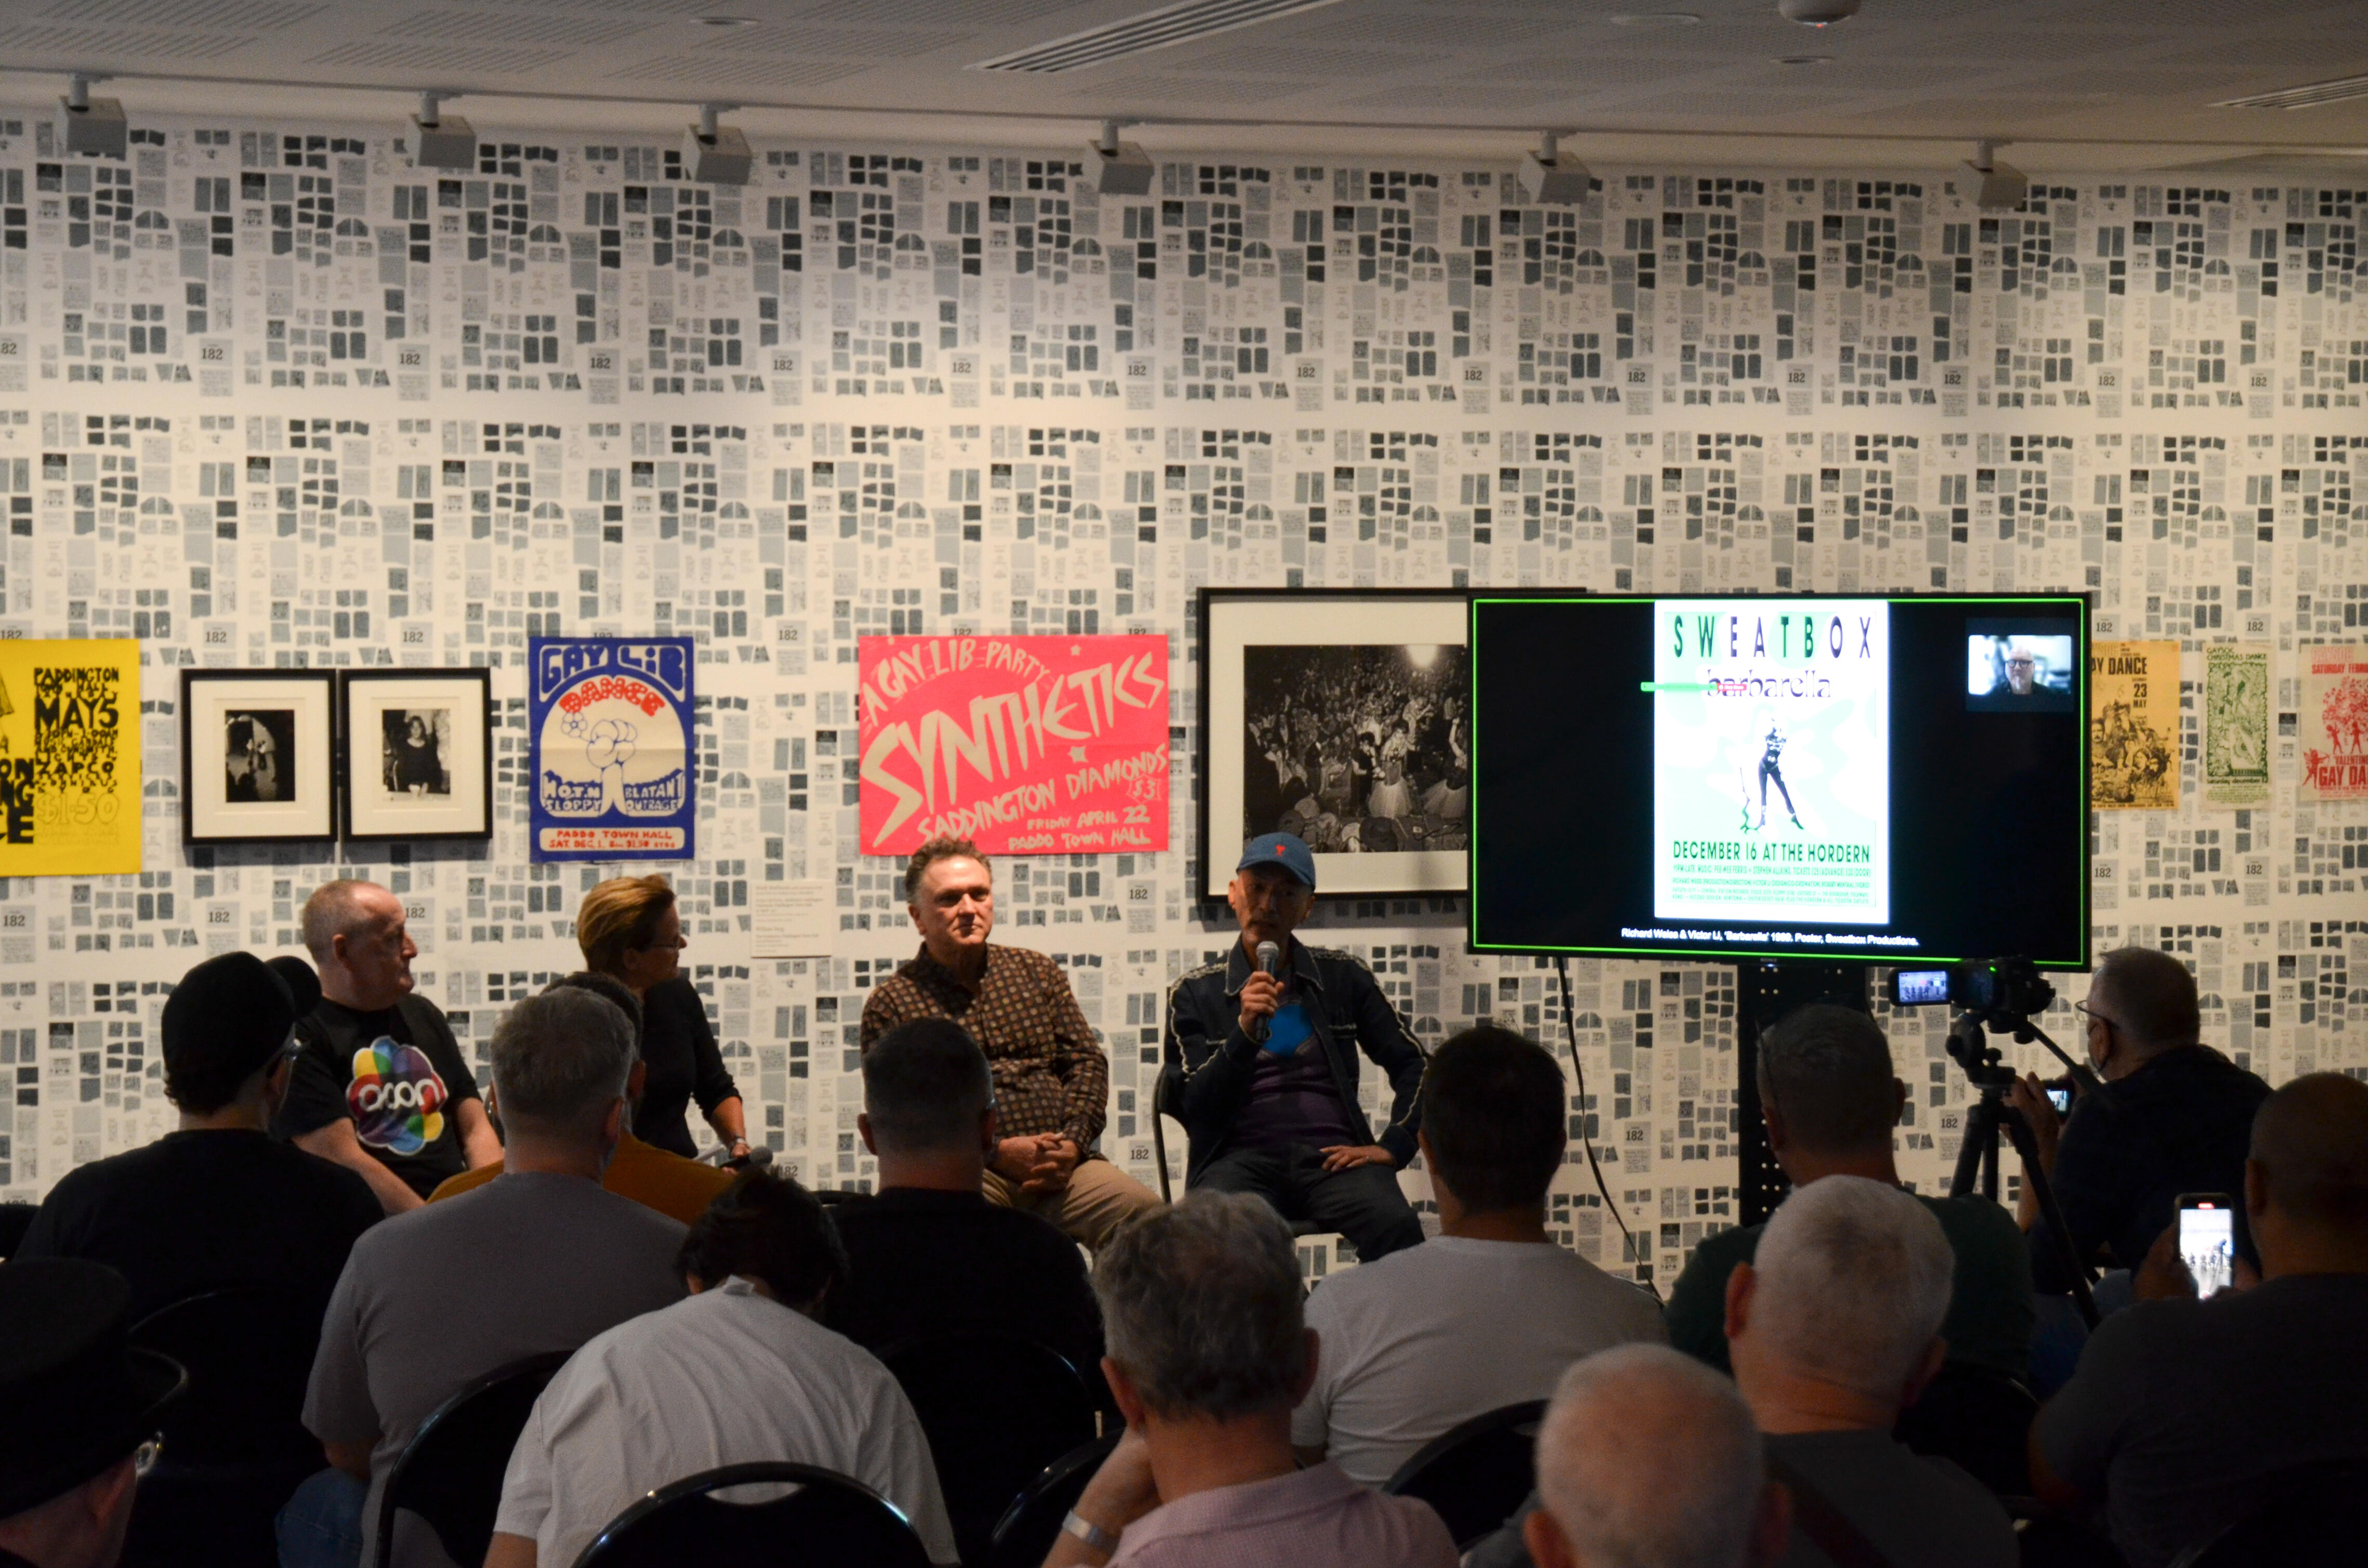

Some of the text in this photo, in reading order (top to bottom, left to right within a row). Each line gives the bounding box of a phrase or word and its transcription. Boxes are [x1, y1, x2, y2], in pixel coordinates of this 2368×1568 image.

[0, 343, 17, 354] 82
[201, 349, 223, 360] 182
[399, 353, 421, 364] 182
[590, 357, 611, 368] 182
[773, 360, 792, 370] 182
[952, 362, 971, 373] 182
[1128, 365, 1146, 376] 182
[1297, 367, 1315, 377] 182
[1464, 370, 1482, 380] 182
[1628, 371, 1646, 382] 182
[1788, 373, 1805, 383] 182
[1944, 374, 1961, 384] 182
[2098, 376, 2115, 386] 182
[2251, 377, 2267, 387] 182
[2096, 622, 2112, 632] 182
[2247, 621, 2264, 631] 182
[205, 631, 227, 642] 182
[402, 631, 423, 642] 182
[778, 630, 798, 640] 182
[541, 646, 605, 694] GAY
[2108, 657, 2147, 675] DANCE
[2312, 664, 2345, 674] SATURDAY
[34, 668, 118, 684] PADDINGTON
[862, 639, 1050, 727] A GAY LIB PARTY
[1706, 669, 1831, 697] barbarella
[2134, 683, 2147, 698] 23
[559, 677, 665, 716] DANCE
[2133, 699, 2147, 708] MAY
[34, 692, 119, 729] MAY 5
[859, 651, 1165, 848] SYNTHETICS
[1065, 743, 1167, 800] DIAMONDS
[2319, 766, 2345, 786] GAY
[625, 773, 683, 799] BLATANT
[546, 799, 601, 812] SLOPPY
[626, 799, 678, 811] OUTRAGE
[1027, 804, 1151, 830] FRIDAY APRIL 22
[0, 805, 34, 844] E
[602, 830, 639, 839] TOWN
[642, 831, 673, 839] HALL
[1008, 827, 1152, 852] PADDO TOWN HALL
[1673, 841, 1870, 863] DECEMBER 16 AT THE HORDERN
[2095, 868, 2111, 878] 182
[2246, 865, 2262, 874] 182
[1129, 889, 1148, 899] 182
[3, 915, 25, 927] 182
[208, 911, 230, 922] 182
[1621, 928, 1652, 938] Richard
[1653, 929, 1678, 938] Weiss
[1679, 929, 1687, 939] &
[1688, 930, 1712, 939] Victor
[1825, 934, 1866, 944] Sweatbox
[1867, 935, 1919, 946] Productions.
[1941, 1118, 1957, 1128] 182
[1626, 1130, 1644, 1140] 182
[1130, 1149, 1149, 1160] 182
